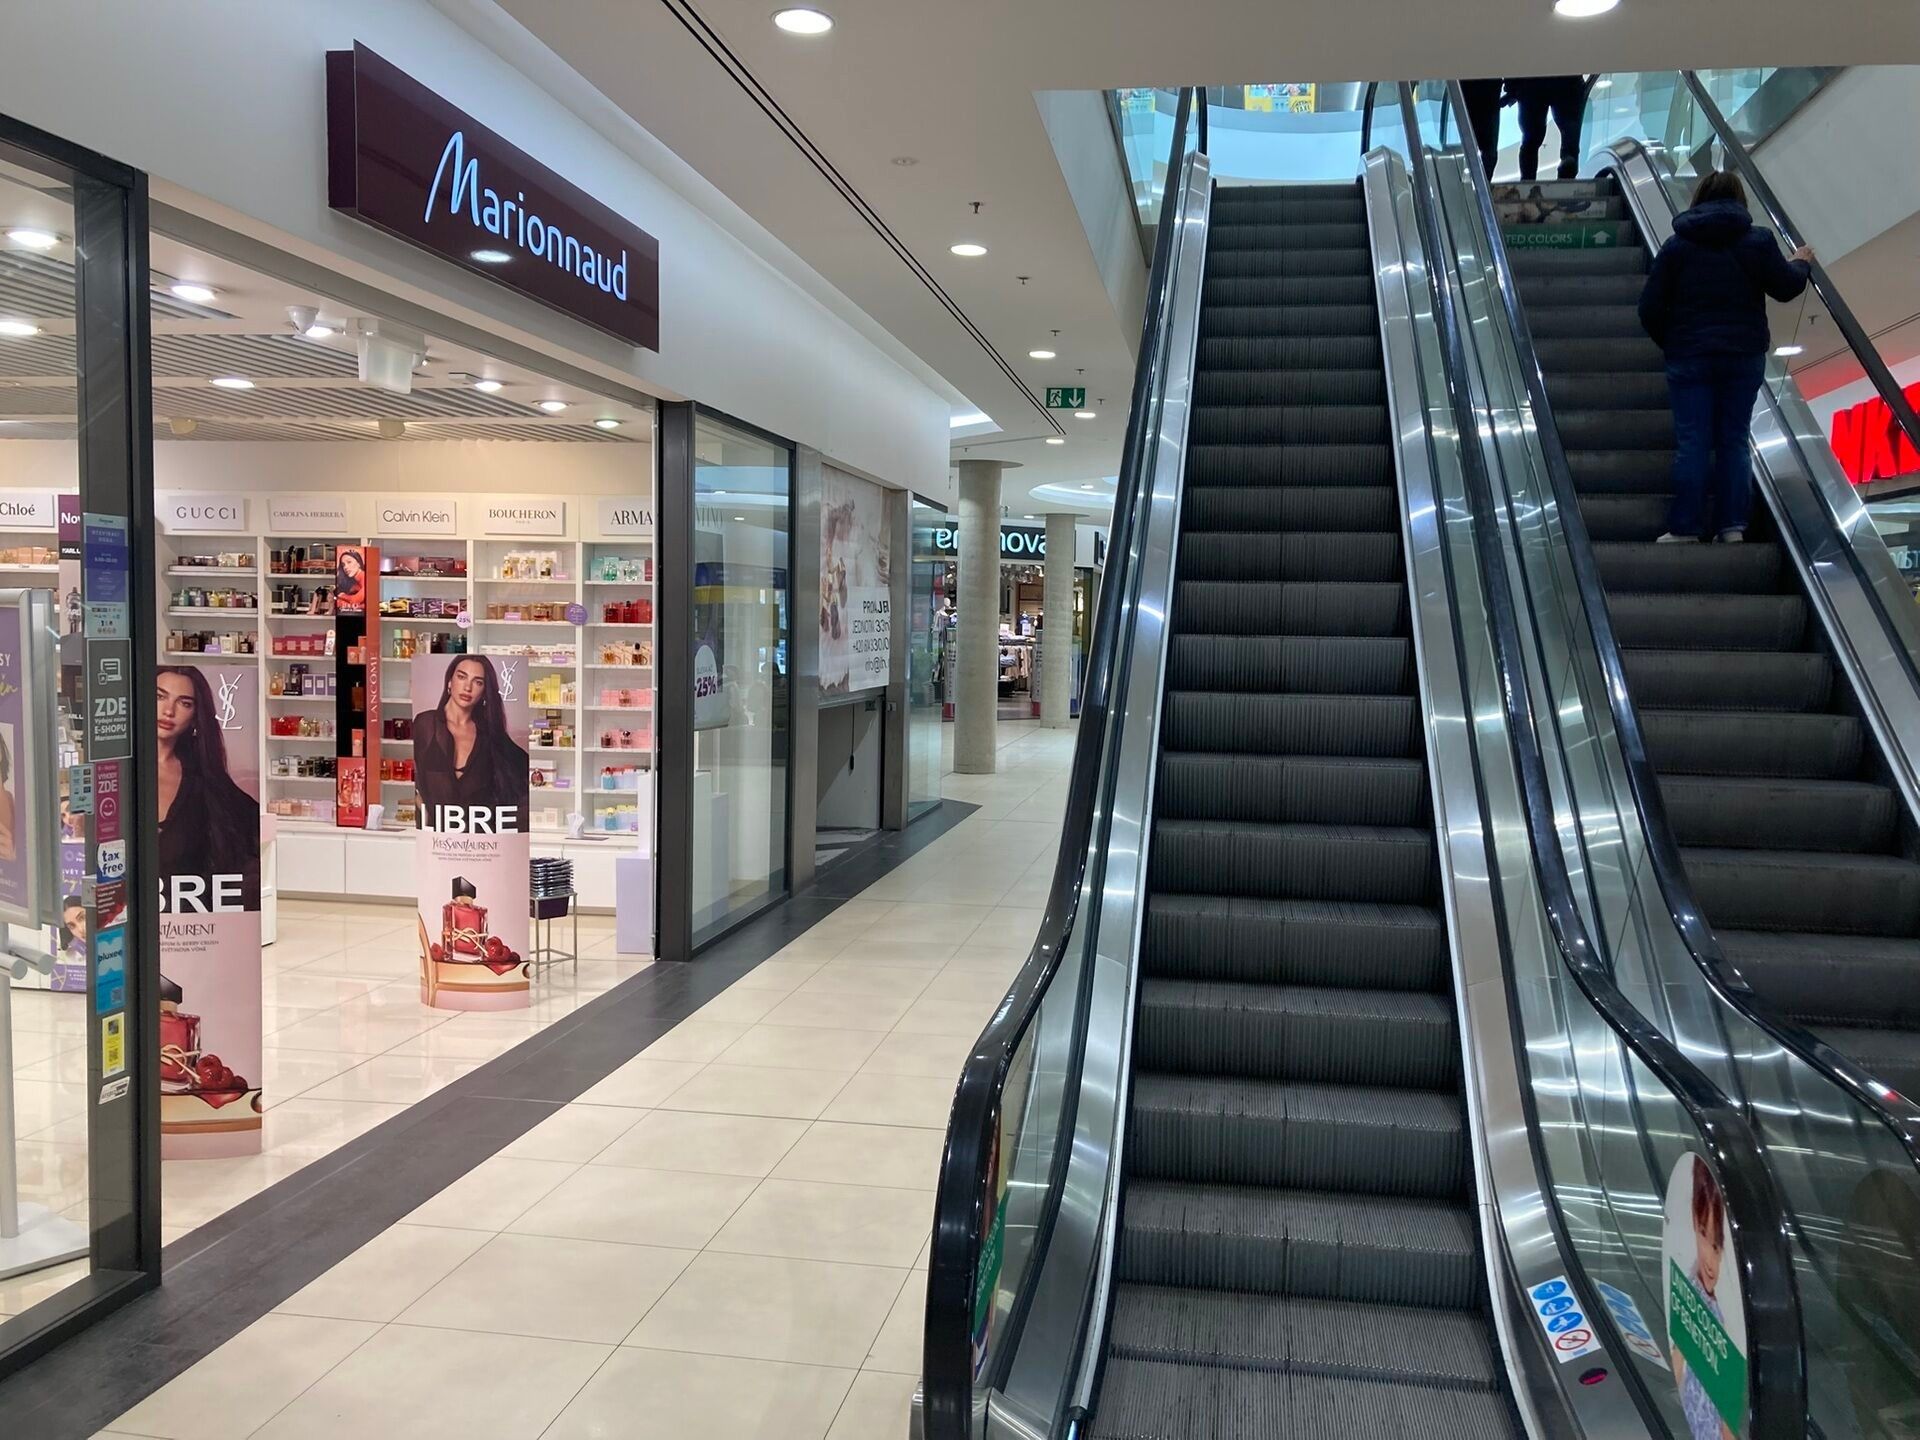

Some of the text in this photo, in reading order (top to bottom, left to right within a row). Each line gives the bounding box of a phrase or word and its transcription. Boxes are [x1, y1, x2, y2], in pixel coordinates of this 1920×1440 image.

[424, 130, 628, 302] Marionnaud
[1528, 234, 1572, 243] COLORS
[0, 502, 36, 516] Chloé
[176, 506, 236, 520] GUCCI
[382, 509, 450, 523] Calvin Klein
[488, 508, 557, 520] BOUCHERON
[94, 696, 127, 717] ZDE
[94, 723, 127, 735] E-SHOPU
[98, 779, 118, 794] ZDE
[420, 802, 519, 835] LIBRE
[102, 850, 120, 863] tax
[101, 861, 125, 878] free
[98, 947, 123, 963] pluxee
[1671, 1291, 1682, 1316] OF
[1696, 1303, 1728, 1360] COLORS
